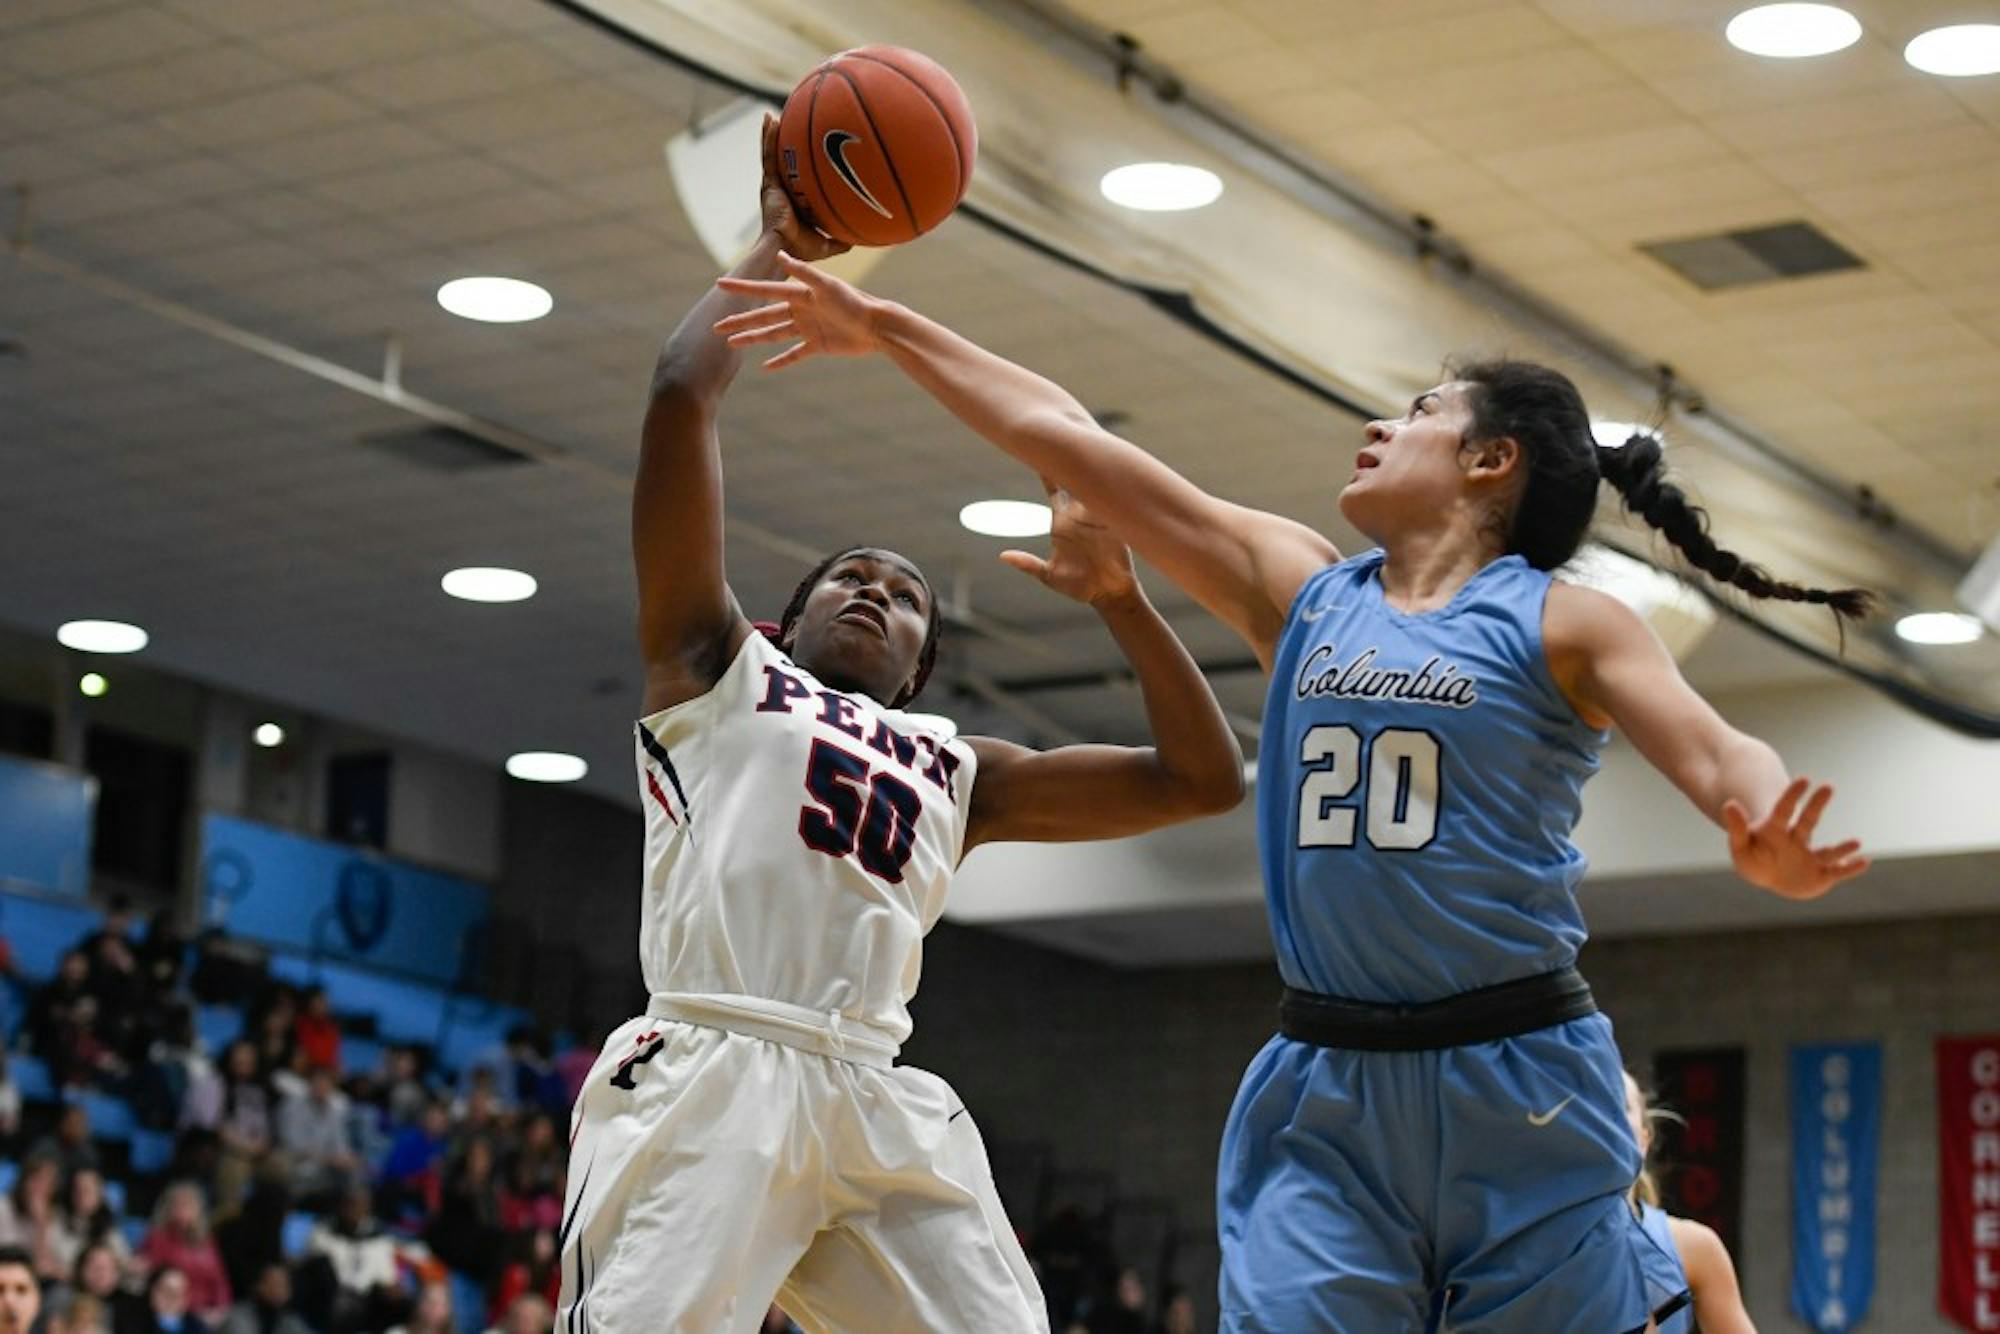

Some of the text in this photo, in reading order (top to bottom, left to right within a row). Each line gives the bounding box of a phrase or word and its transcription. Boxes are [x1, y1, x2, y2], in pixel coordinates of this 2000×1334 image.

[756, 664, 960, 806] PENN
[1297, 645, 1478, 708] Columbia
[798, 737, 922, 884] 50
[1298, 723, 1442, 850] 20
[1818, 1054, 1851, 1330] COLUMBIA
[1970, 1049, 2000, 1331] CORNELL
